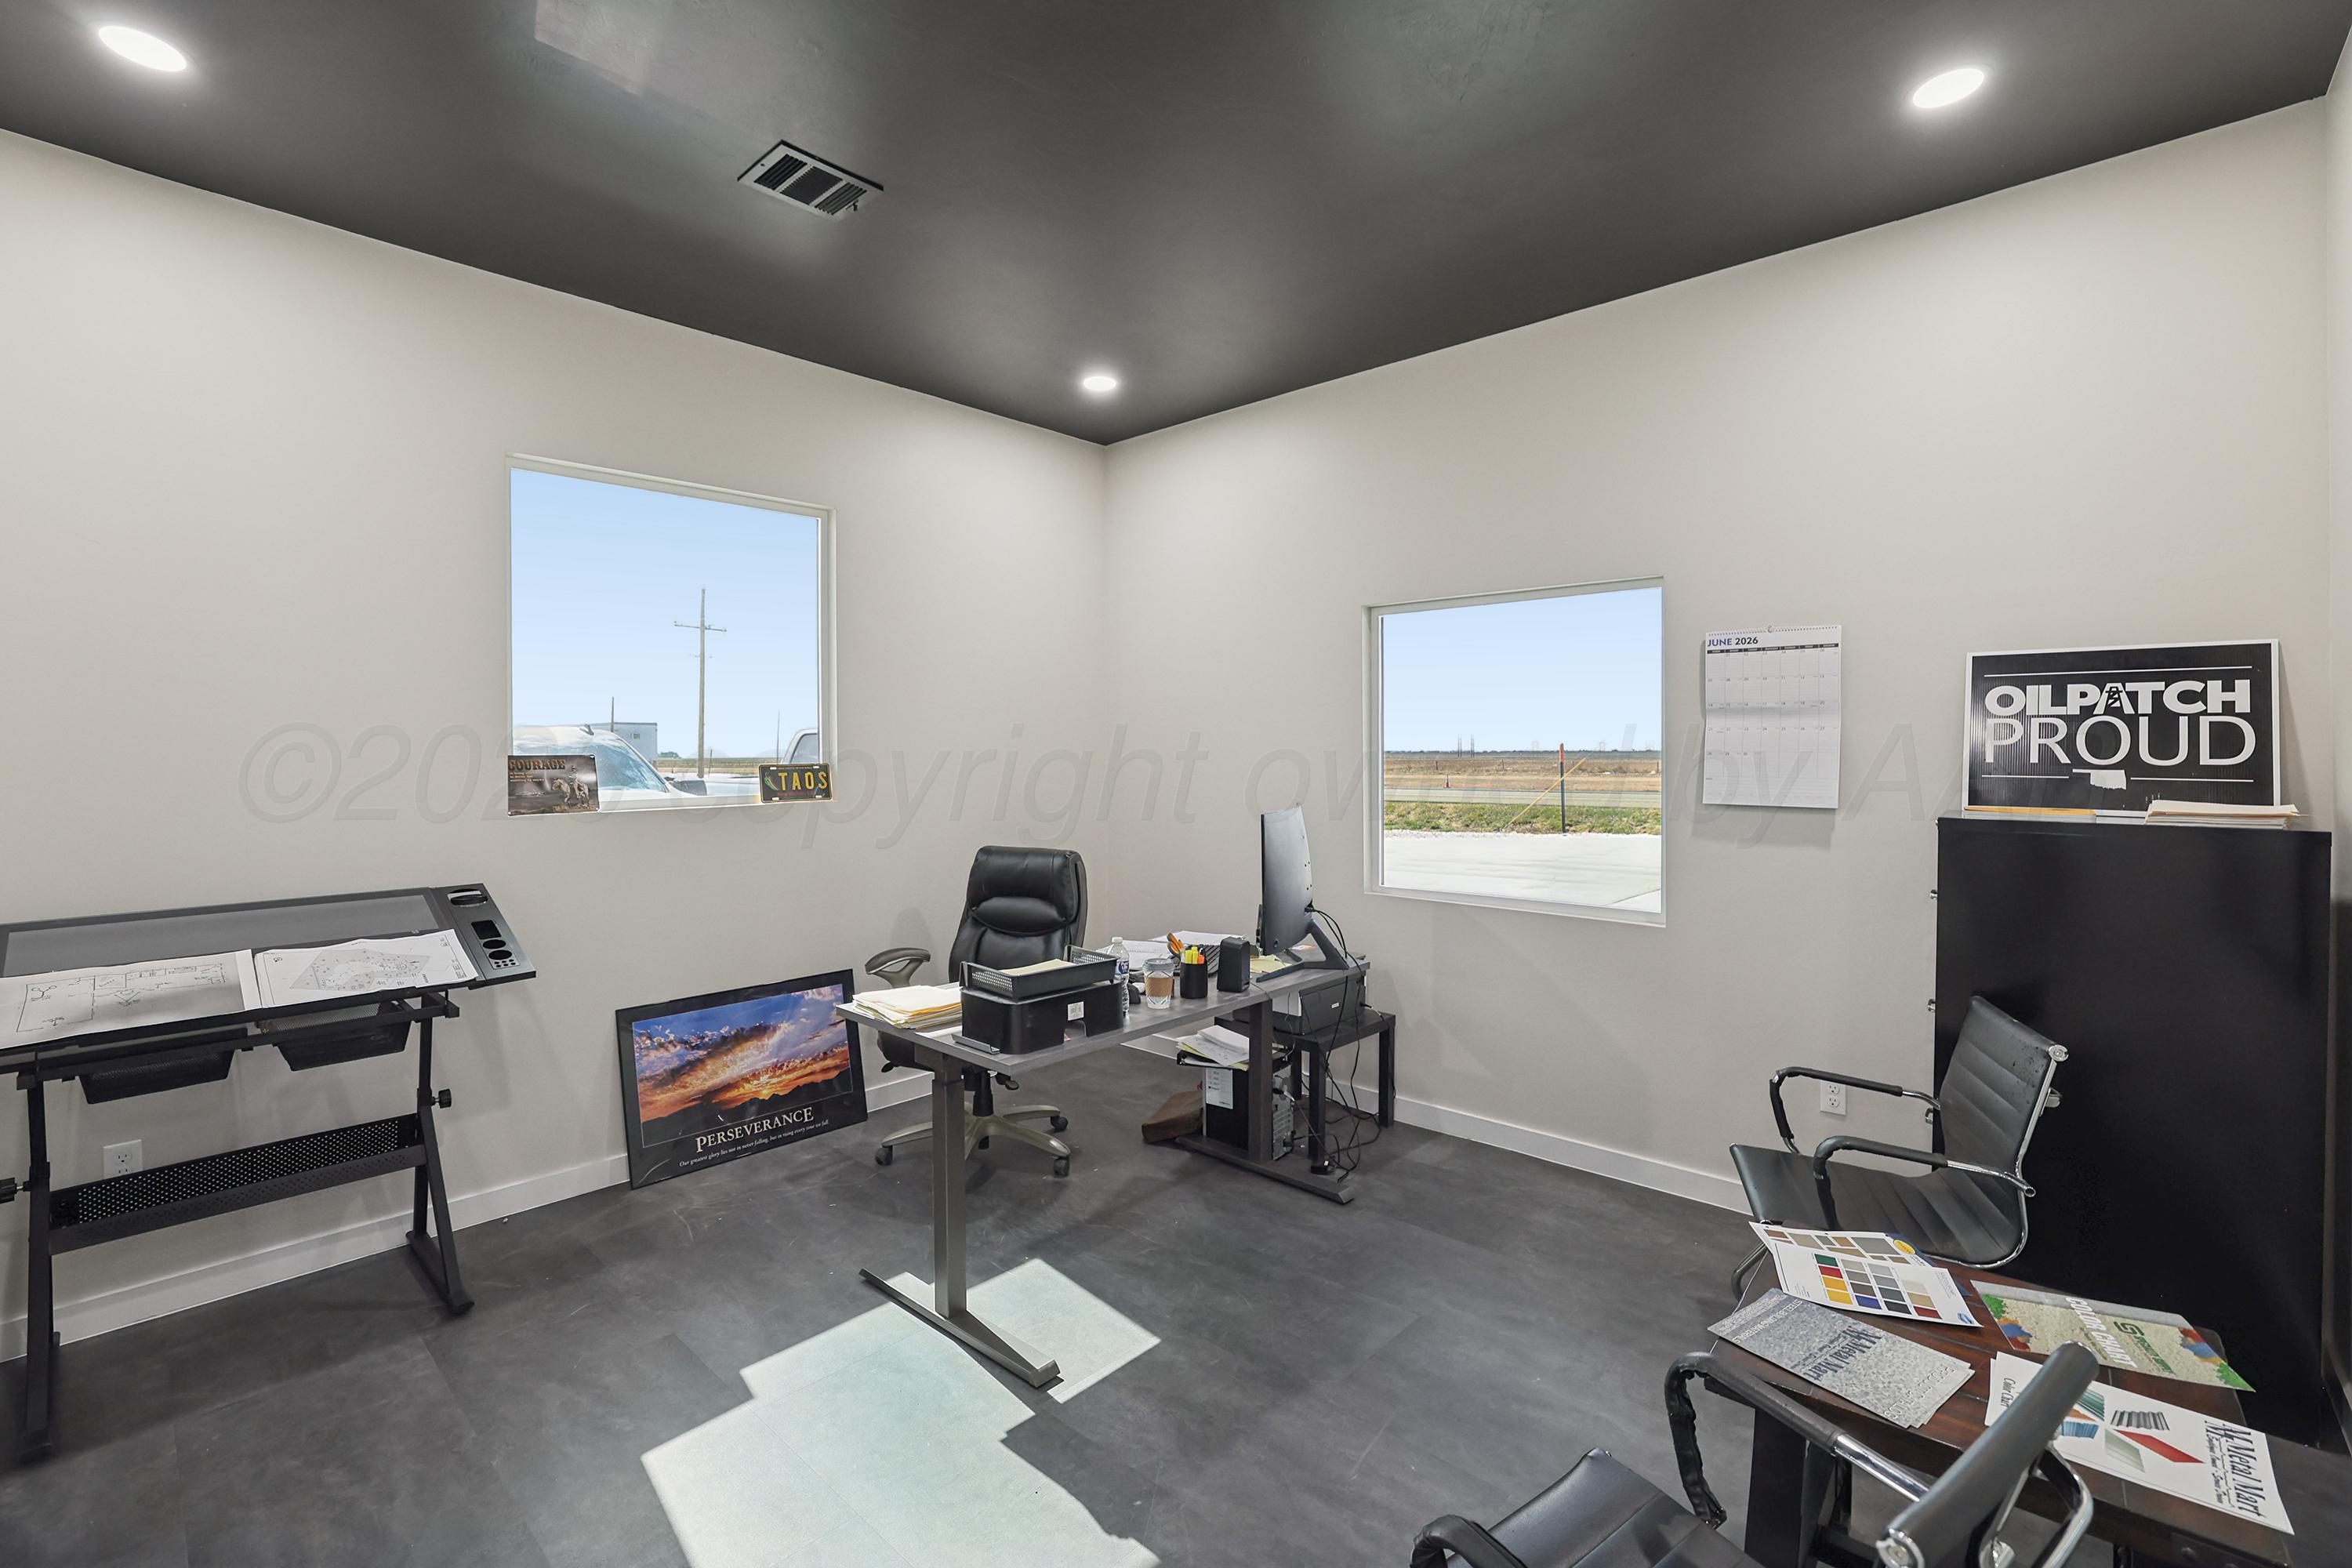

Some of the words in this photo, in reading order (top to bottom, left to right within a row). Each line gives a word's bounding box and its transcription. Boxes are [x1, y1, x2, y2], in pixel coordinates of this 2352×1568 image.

[1708, 638, 1733, 647] JUNE
[1735, 637, 1759, 645] 2026
[1984, 679, 2251, 716] OILPATCH
[1984, 716, 2256, 766] PROUD
[508, 758, 566, 771] COURAGE
[778, 771, 828, 791] TAOS
[695, 1107, 815, 1153] PERSEVERANCE
[2065, 1298, 2107, 1331] COLOR
[2091, 1331, 2138, 1368] CHART
[1829, 1337, 1867, 1367] Metal
[1804, 1358, 1846, 1382] Mart
[2002, 1377, 2016, 1393] Color
[2226, 1439, 2263, 1483] Metal
[2232, 1478, 2268, 1519] Mart
